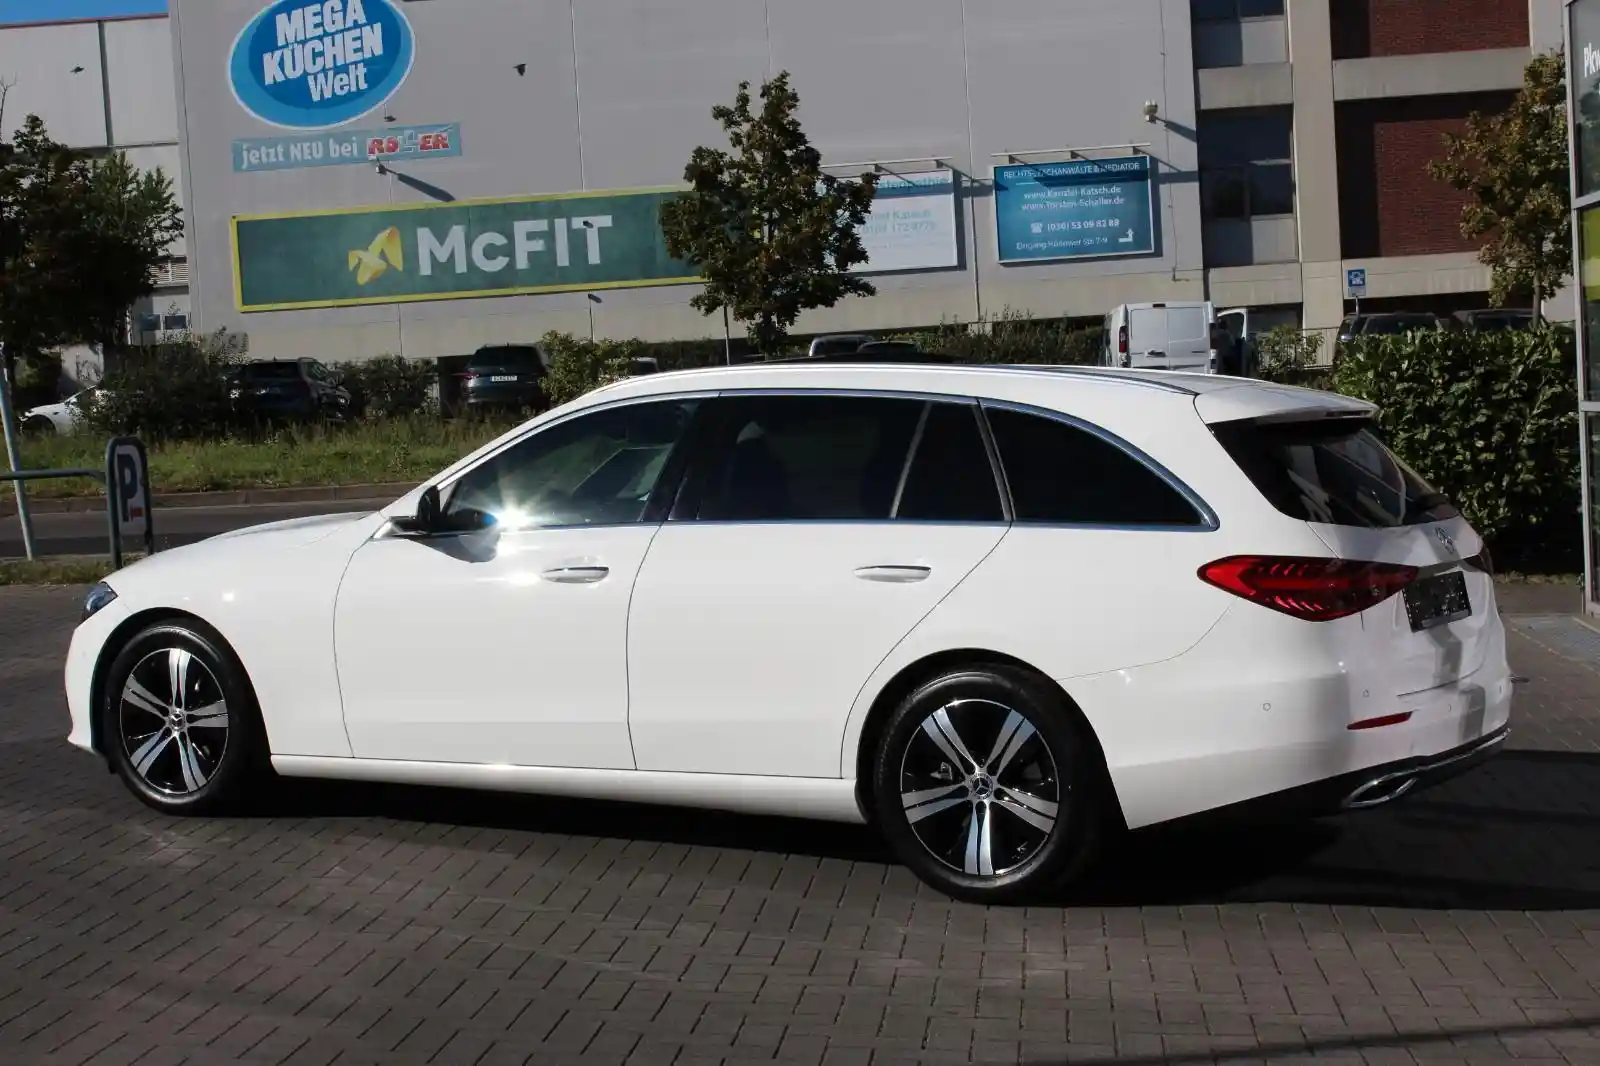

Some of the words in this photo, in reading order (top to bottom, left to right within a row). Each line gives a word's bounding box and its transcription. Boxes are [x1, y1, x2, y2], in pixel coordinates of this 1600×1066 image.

[275, 0, 367, 46] MEGA
[262, 22, 384, 86] KÜCHEN
[307, 62, 368, 103] Welt
[241, 142, 285, 170] jetzt
[289, 141, 323, 161] NEU
[328, 136, 358, 158] bei
[415, 214, 613, 276] McFIT
[117, 454, 137, 521] P
